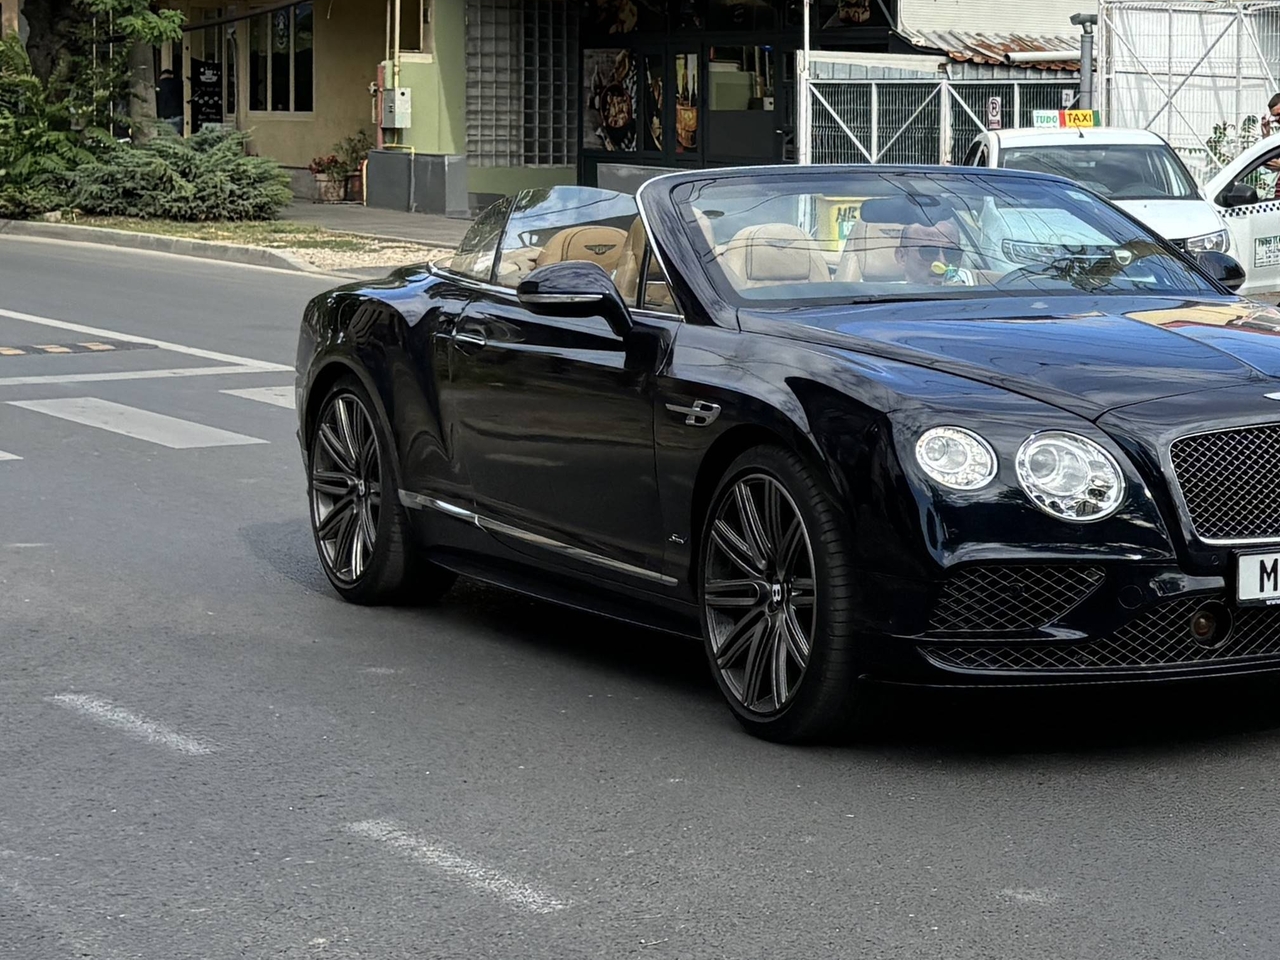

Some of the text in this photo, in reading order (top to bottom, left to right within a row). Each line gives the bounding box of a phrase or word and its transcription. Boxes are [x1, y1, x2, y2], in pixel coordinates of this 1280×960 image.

[1036, 115, 1058, 124] TUDO
[1067, 113, 1092, 123] TAXI
[1259, 558, 1279, 593] M
